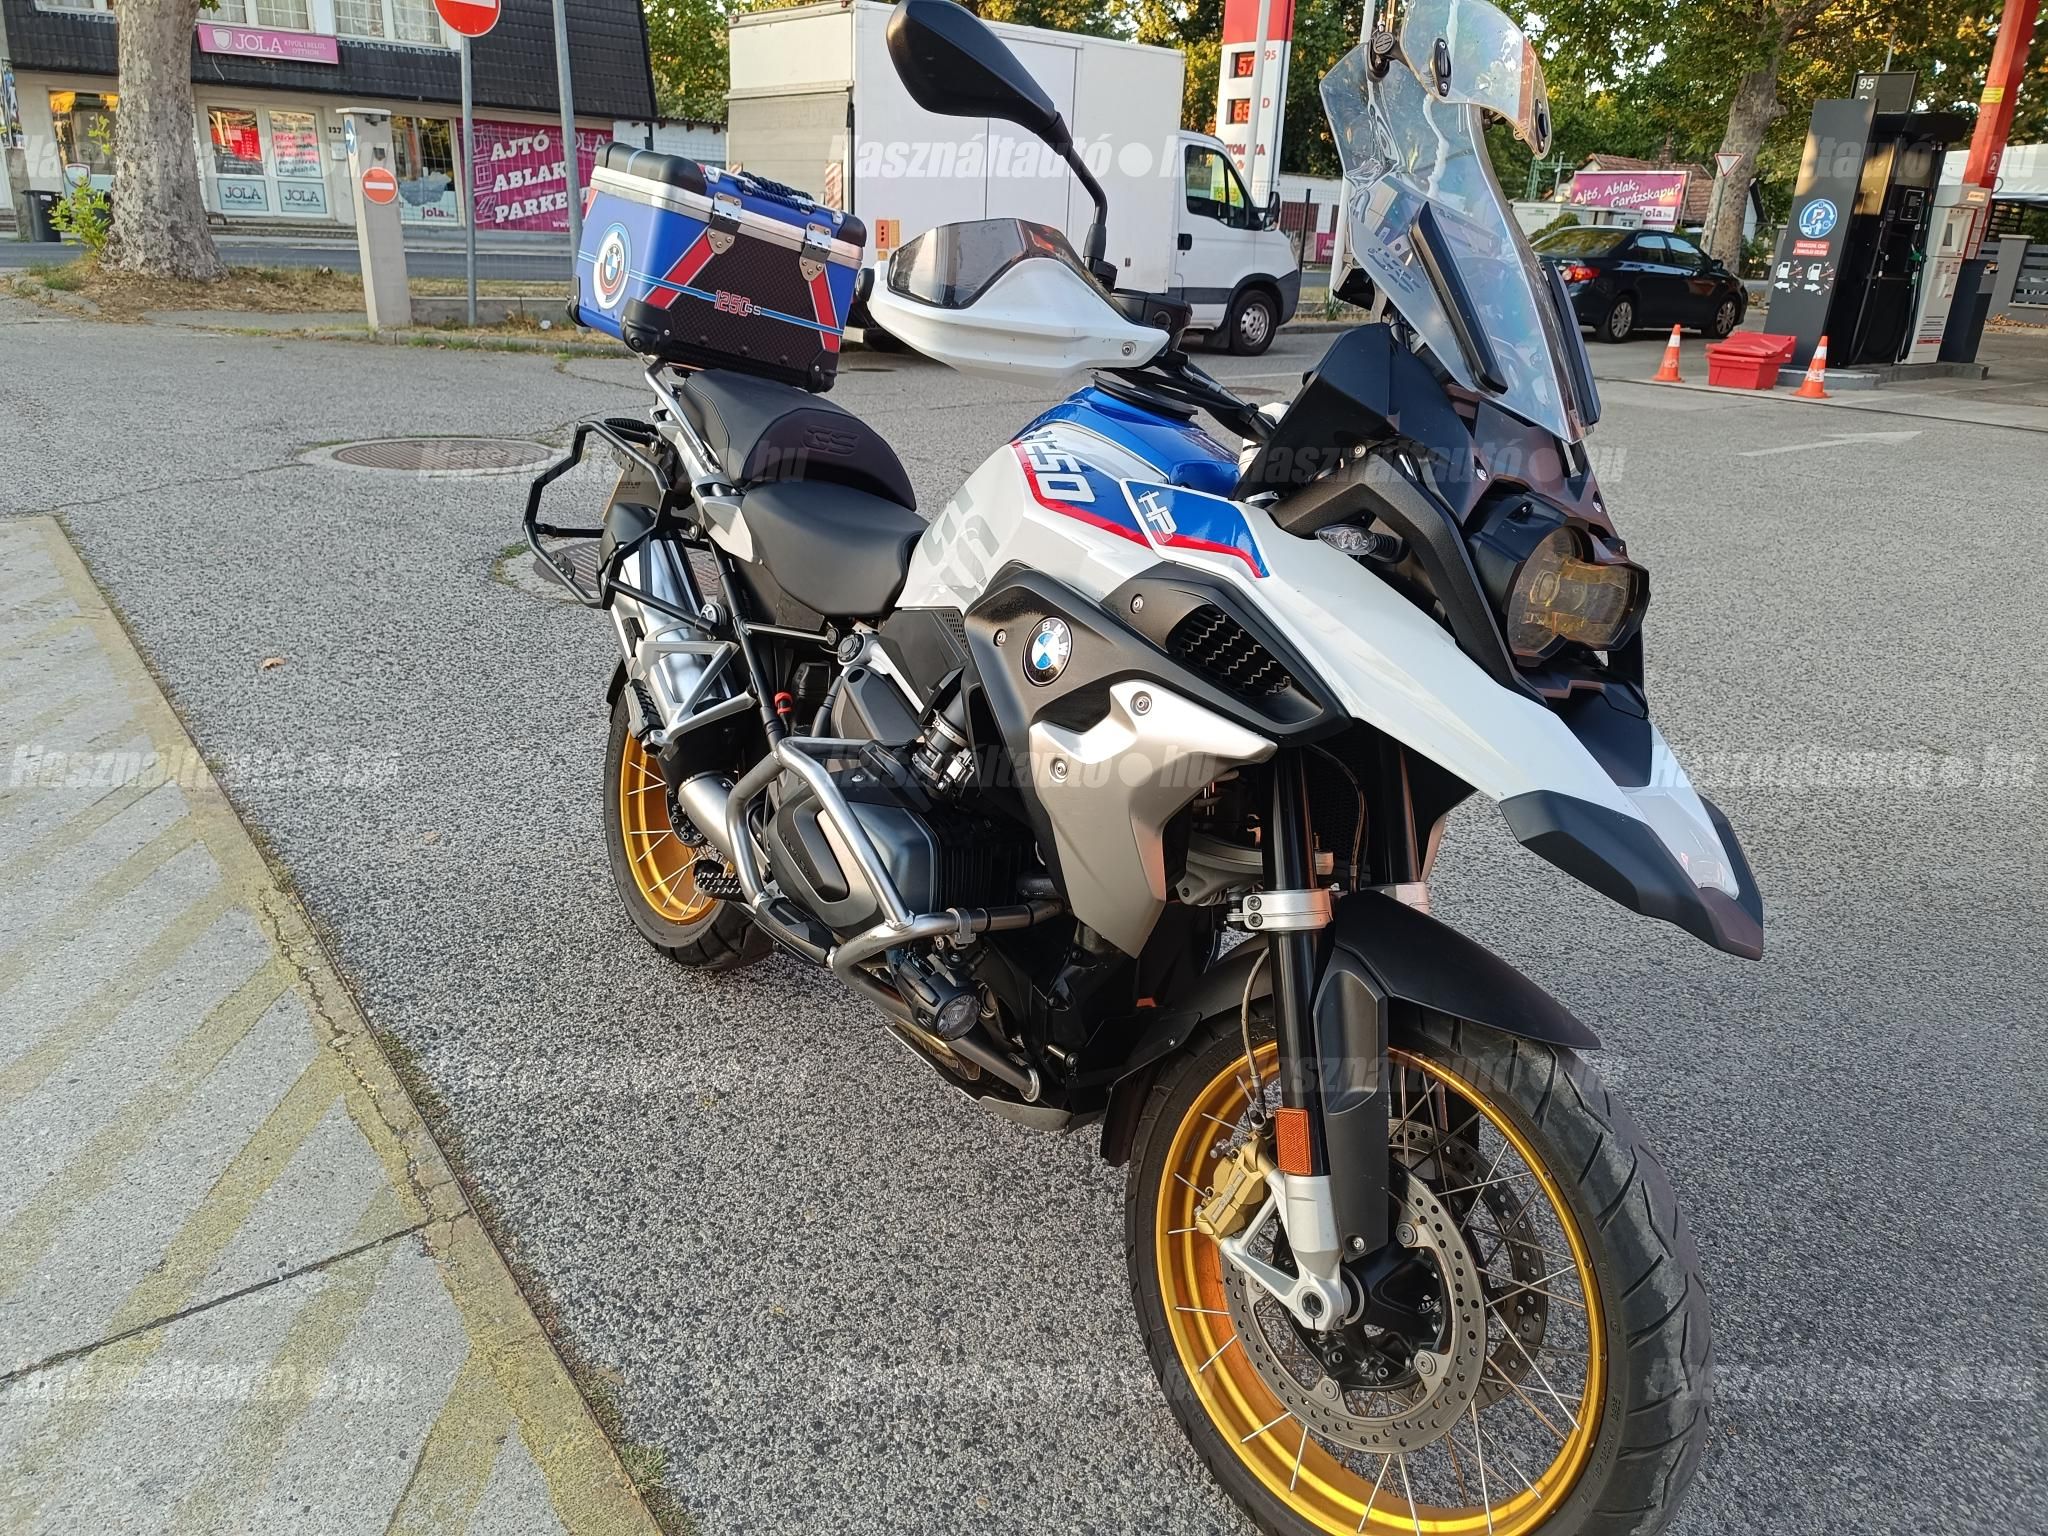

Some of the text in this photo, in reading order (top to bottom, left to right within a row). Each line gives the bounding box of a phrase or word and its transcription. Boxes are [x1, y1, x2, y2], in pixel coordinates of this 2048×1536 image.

[235, 34, 284, 53] JOLA
[1238, 50, 1277, 75] 57 95
[1859, 78, 1875, 90] 95
[1262, 97, 1271, 109] D
[328, 126, 342, 134] 127
[489, 129, 549, 161] AJTÓ
[493, 160, 568, 193] ABLAK
[225, 186, 261, 200] JOLA
[285, 189, 320, 202] JOLA
[1604, 179, 1639, 197] Ablak,
[1610, 183, 1681, 208] Garázskapu?
[494, 187, 590, 224] PARKE
[714, 289, 762, 317] 1250 GS
